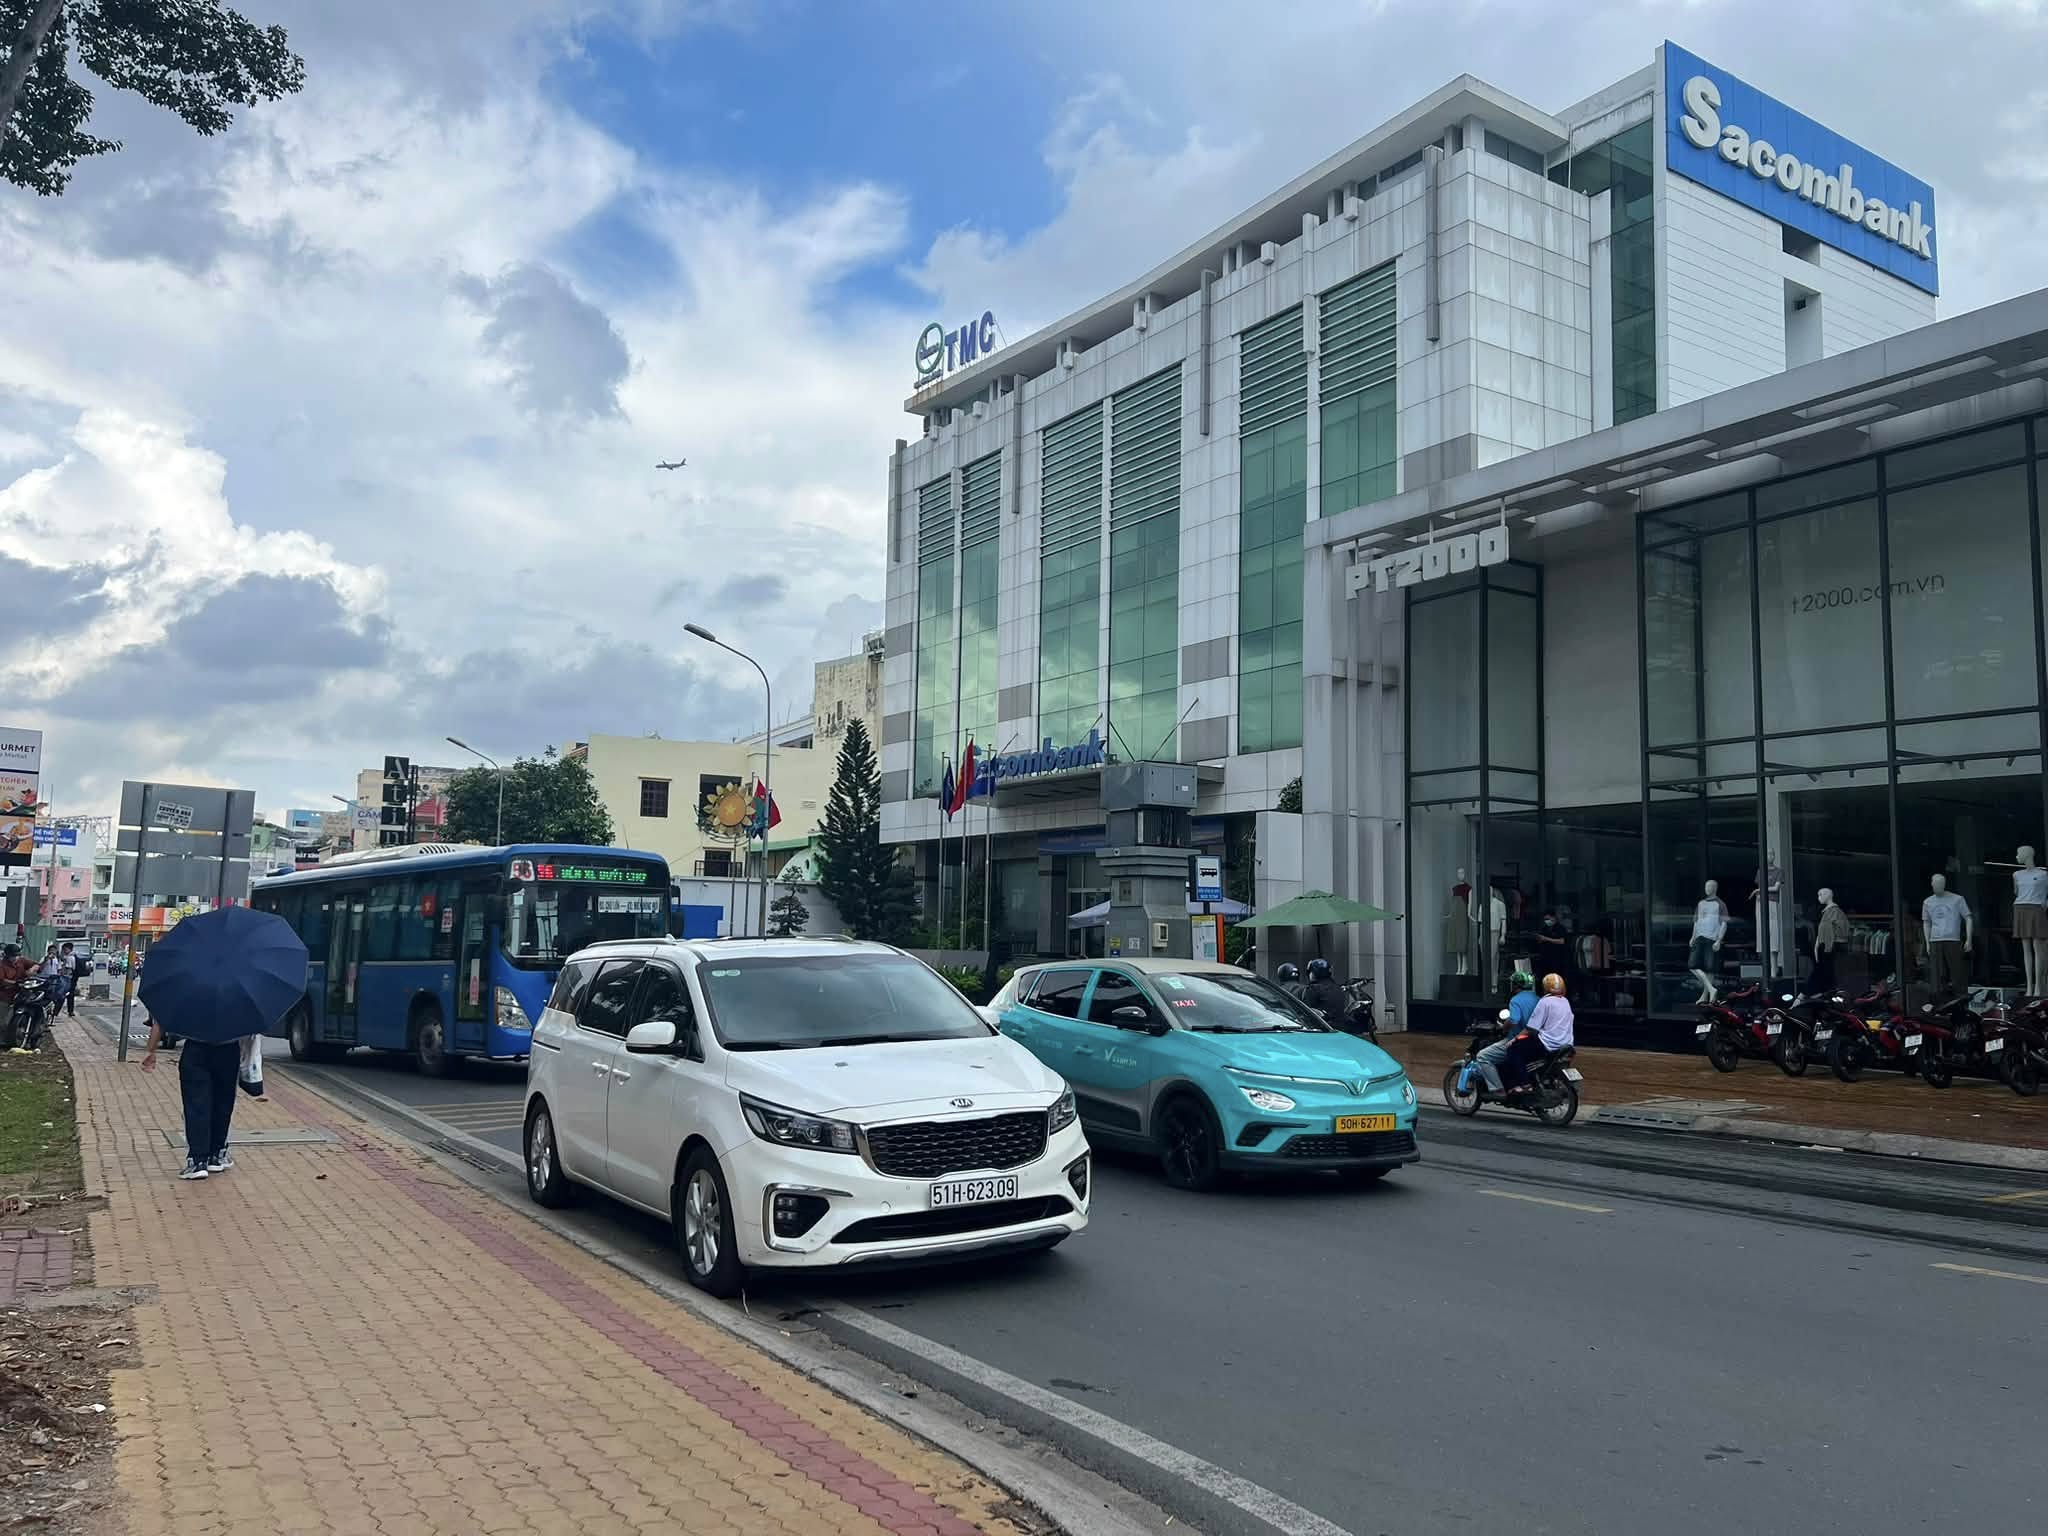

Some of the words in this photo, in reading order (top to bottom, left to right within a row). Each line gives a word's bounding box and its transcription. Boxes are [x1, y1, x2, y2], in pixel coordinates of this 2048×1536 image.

[1680, 75, 1932, 259] Sacombank
[944, 310, 994, 372] TMC
[1345, 525, 1509, 601] PT2000
[1171, 999, 1197, 1008] TAXI
[952, 1098, 974, 1108] KIA
